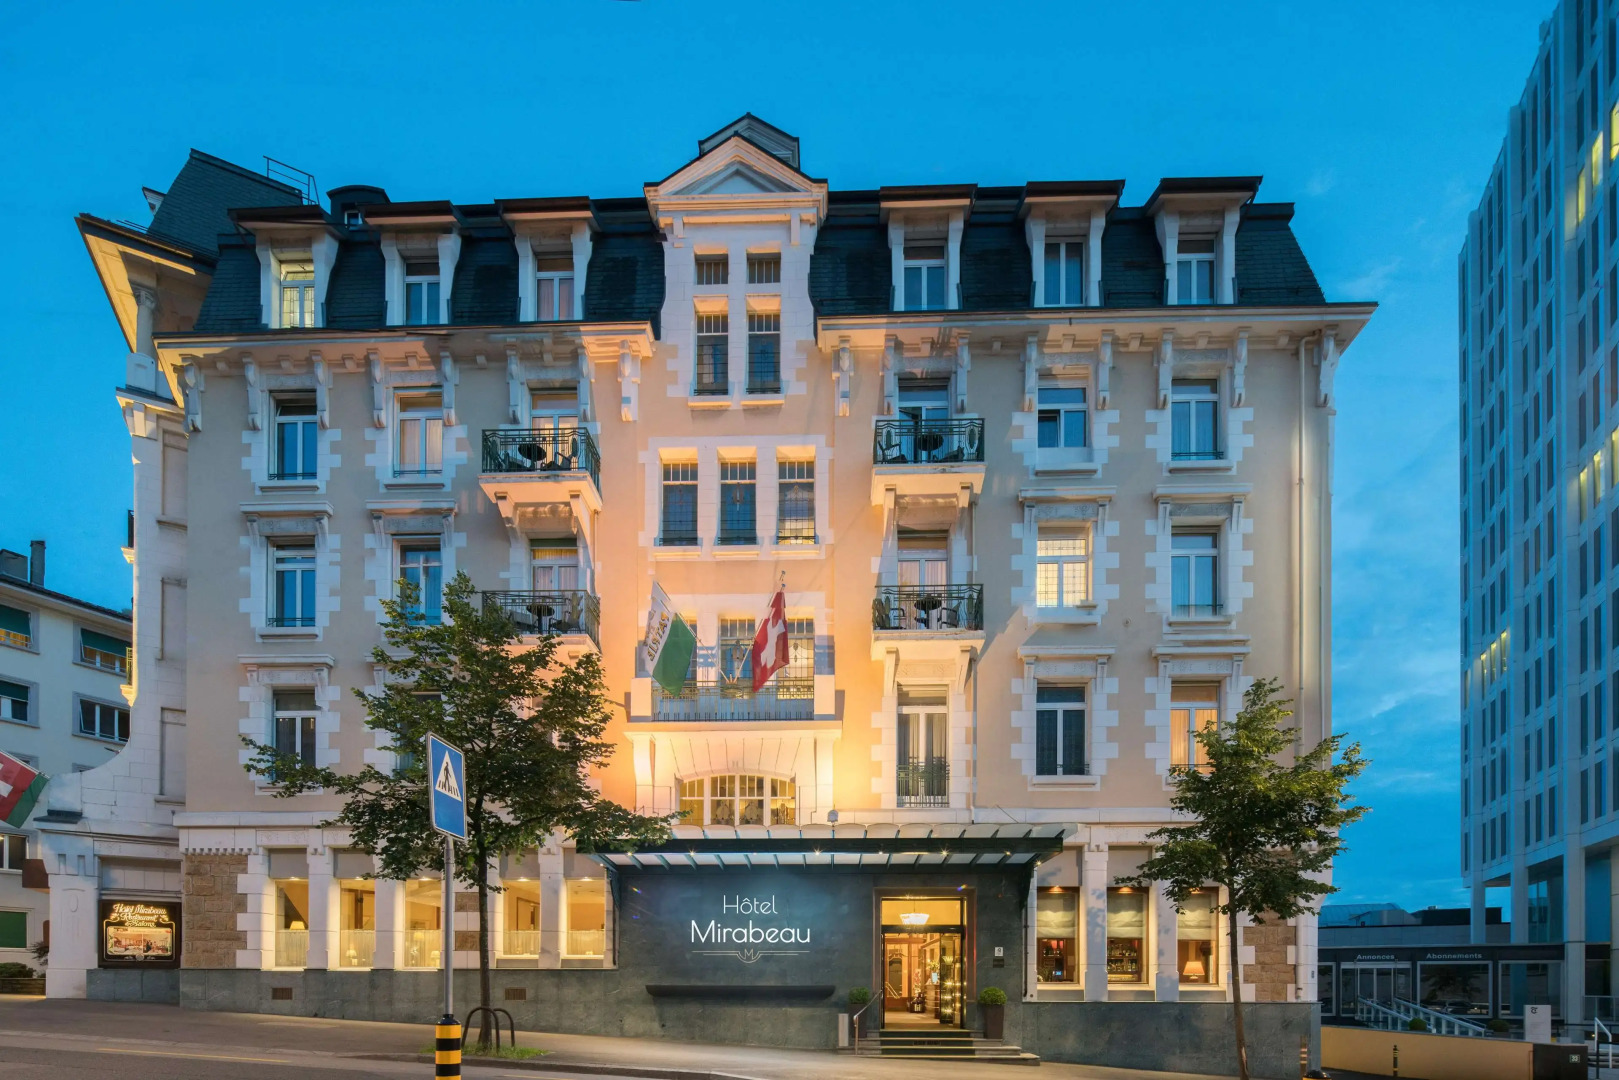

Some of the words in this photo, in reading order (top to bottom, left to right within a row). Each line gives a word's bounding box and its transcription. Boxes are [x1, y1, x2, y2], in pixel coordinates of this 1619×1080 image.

[723, 894, 778, 914] Hôtel
[691, 919, 811, 943] Mirabeau
[744, 948, 754, 960] M
